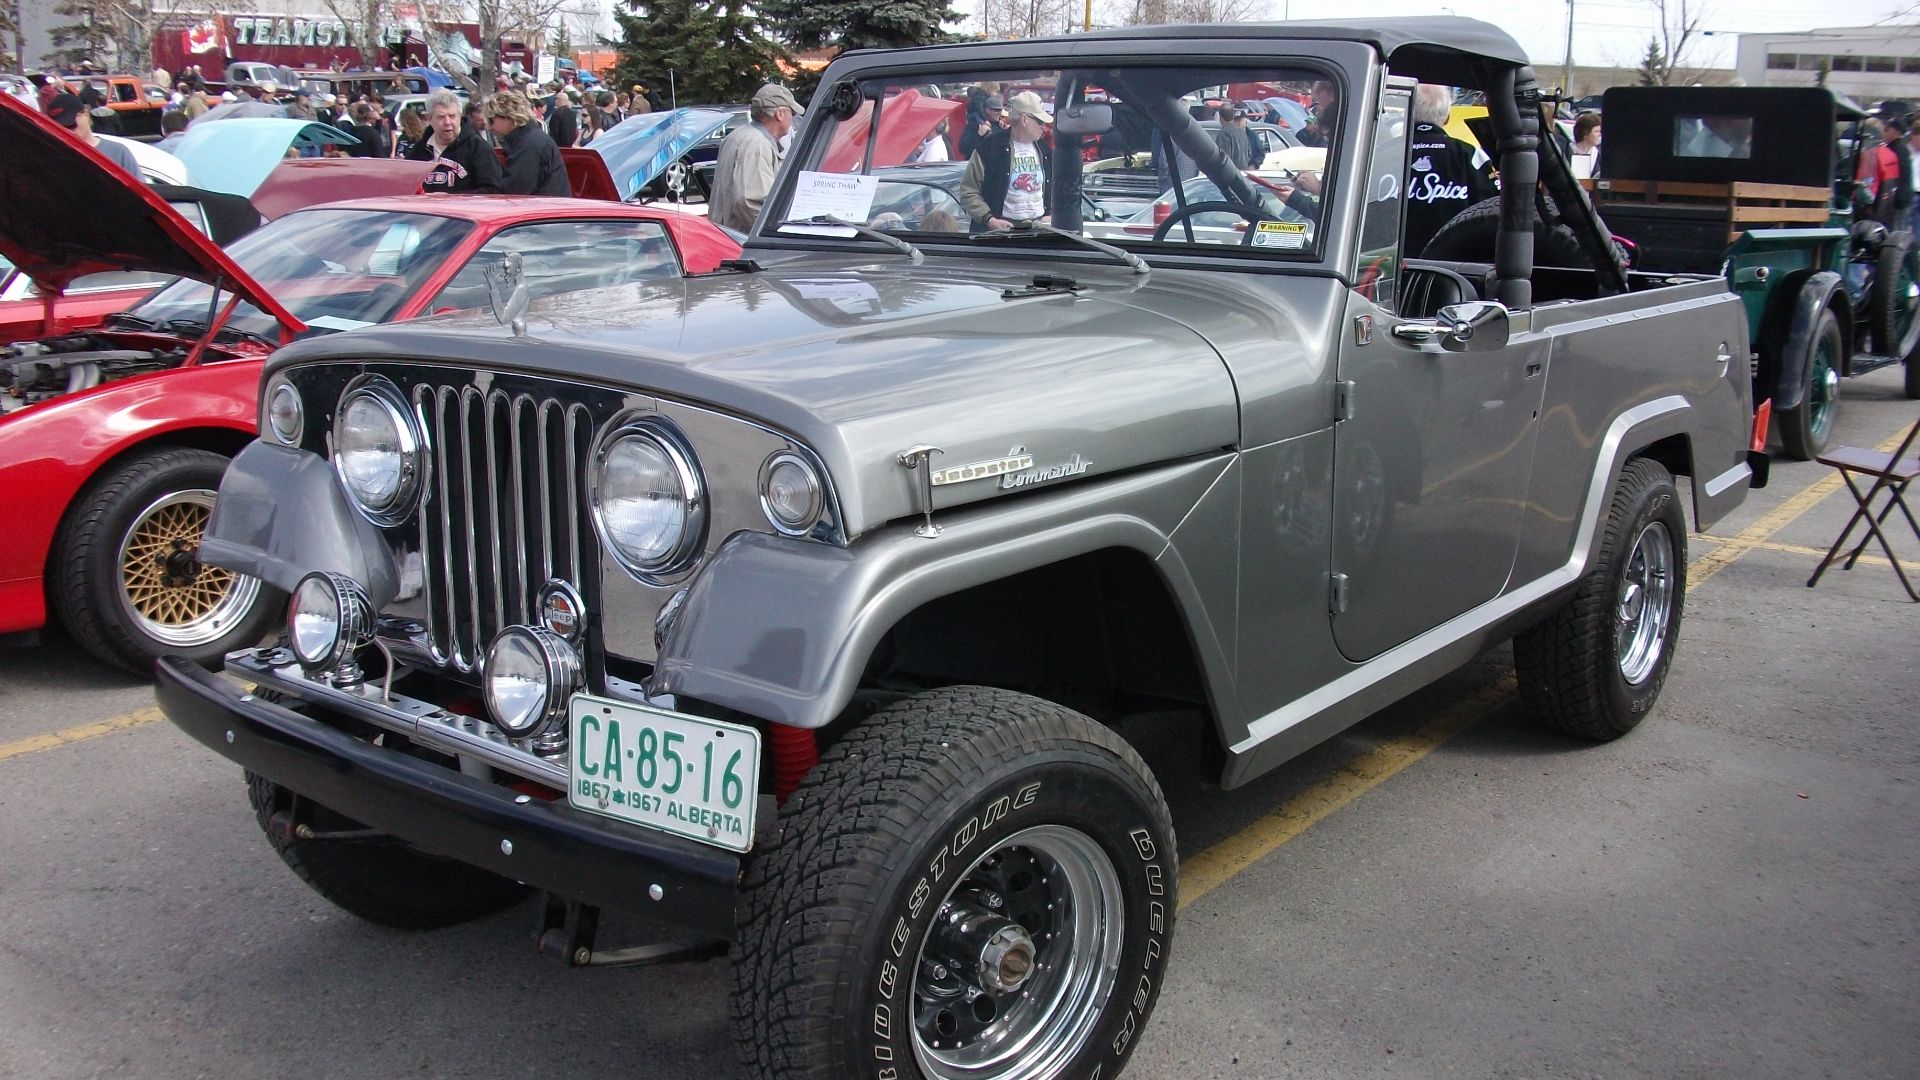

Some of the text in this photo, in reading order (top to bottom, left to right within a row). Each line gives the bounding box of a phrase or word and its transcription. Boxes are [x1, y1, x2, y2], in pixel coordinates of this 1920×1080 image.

[234, 18, 402, 48] TEAMSTS
[812, 180, 836, 189] SPRING
[1416, 173, 1468, 203] Spice
[545, 608, 572, 623] Jeep
[577, 778, 743, 836] 1867 1967 ALBERTA
[1111, 828, 1165, 1057] DUELER
